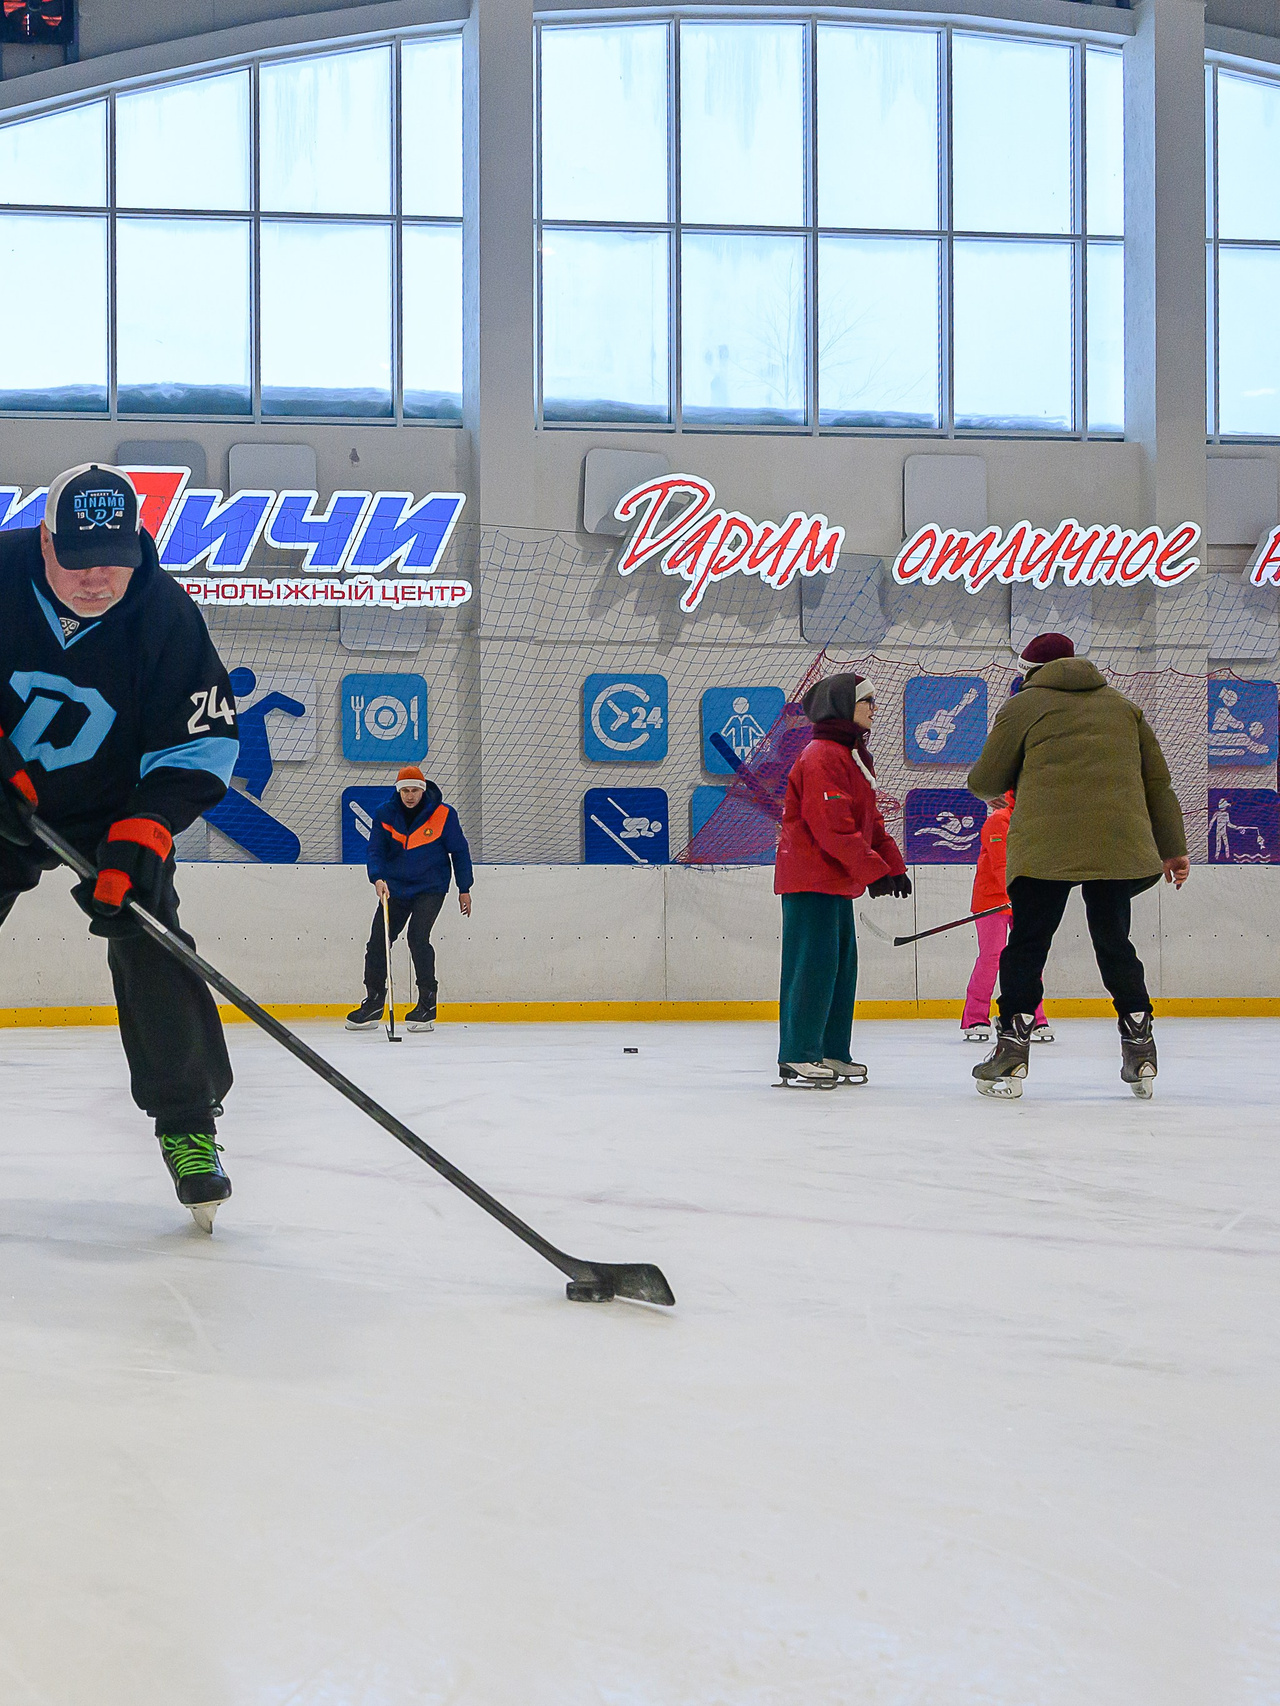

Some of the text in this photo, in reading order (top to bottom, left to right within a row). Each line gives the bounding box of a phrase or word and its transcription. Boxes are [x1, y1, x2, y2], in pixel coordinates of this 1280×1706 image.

[74, 496, 125, 509] DINAMO
[620, 479, 840, 607] Дарим
[897, 523, 1196, 589] отличное
[180, 581, 374, 602] РНОЛЫЖНЫЙ
[381, 585, 467, 605] ЦЕНТР
[187, 685, 235, 735] 24
[631, 706, 664, 729] 24
